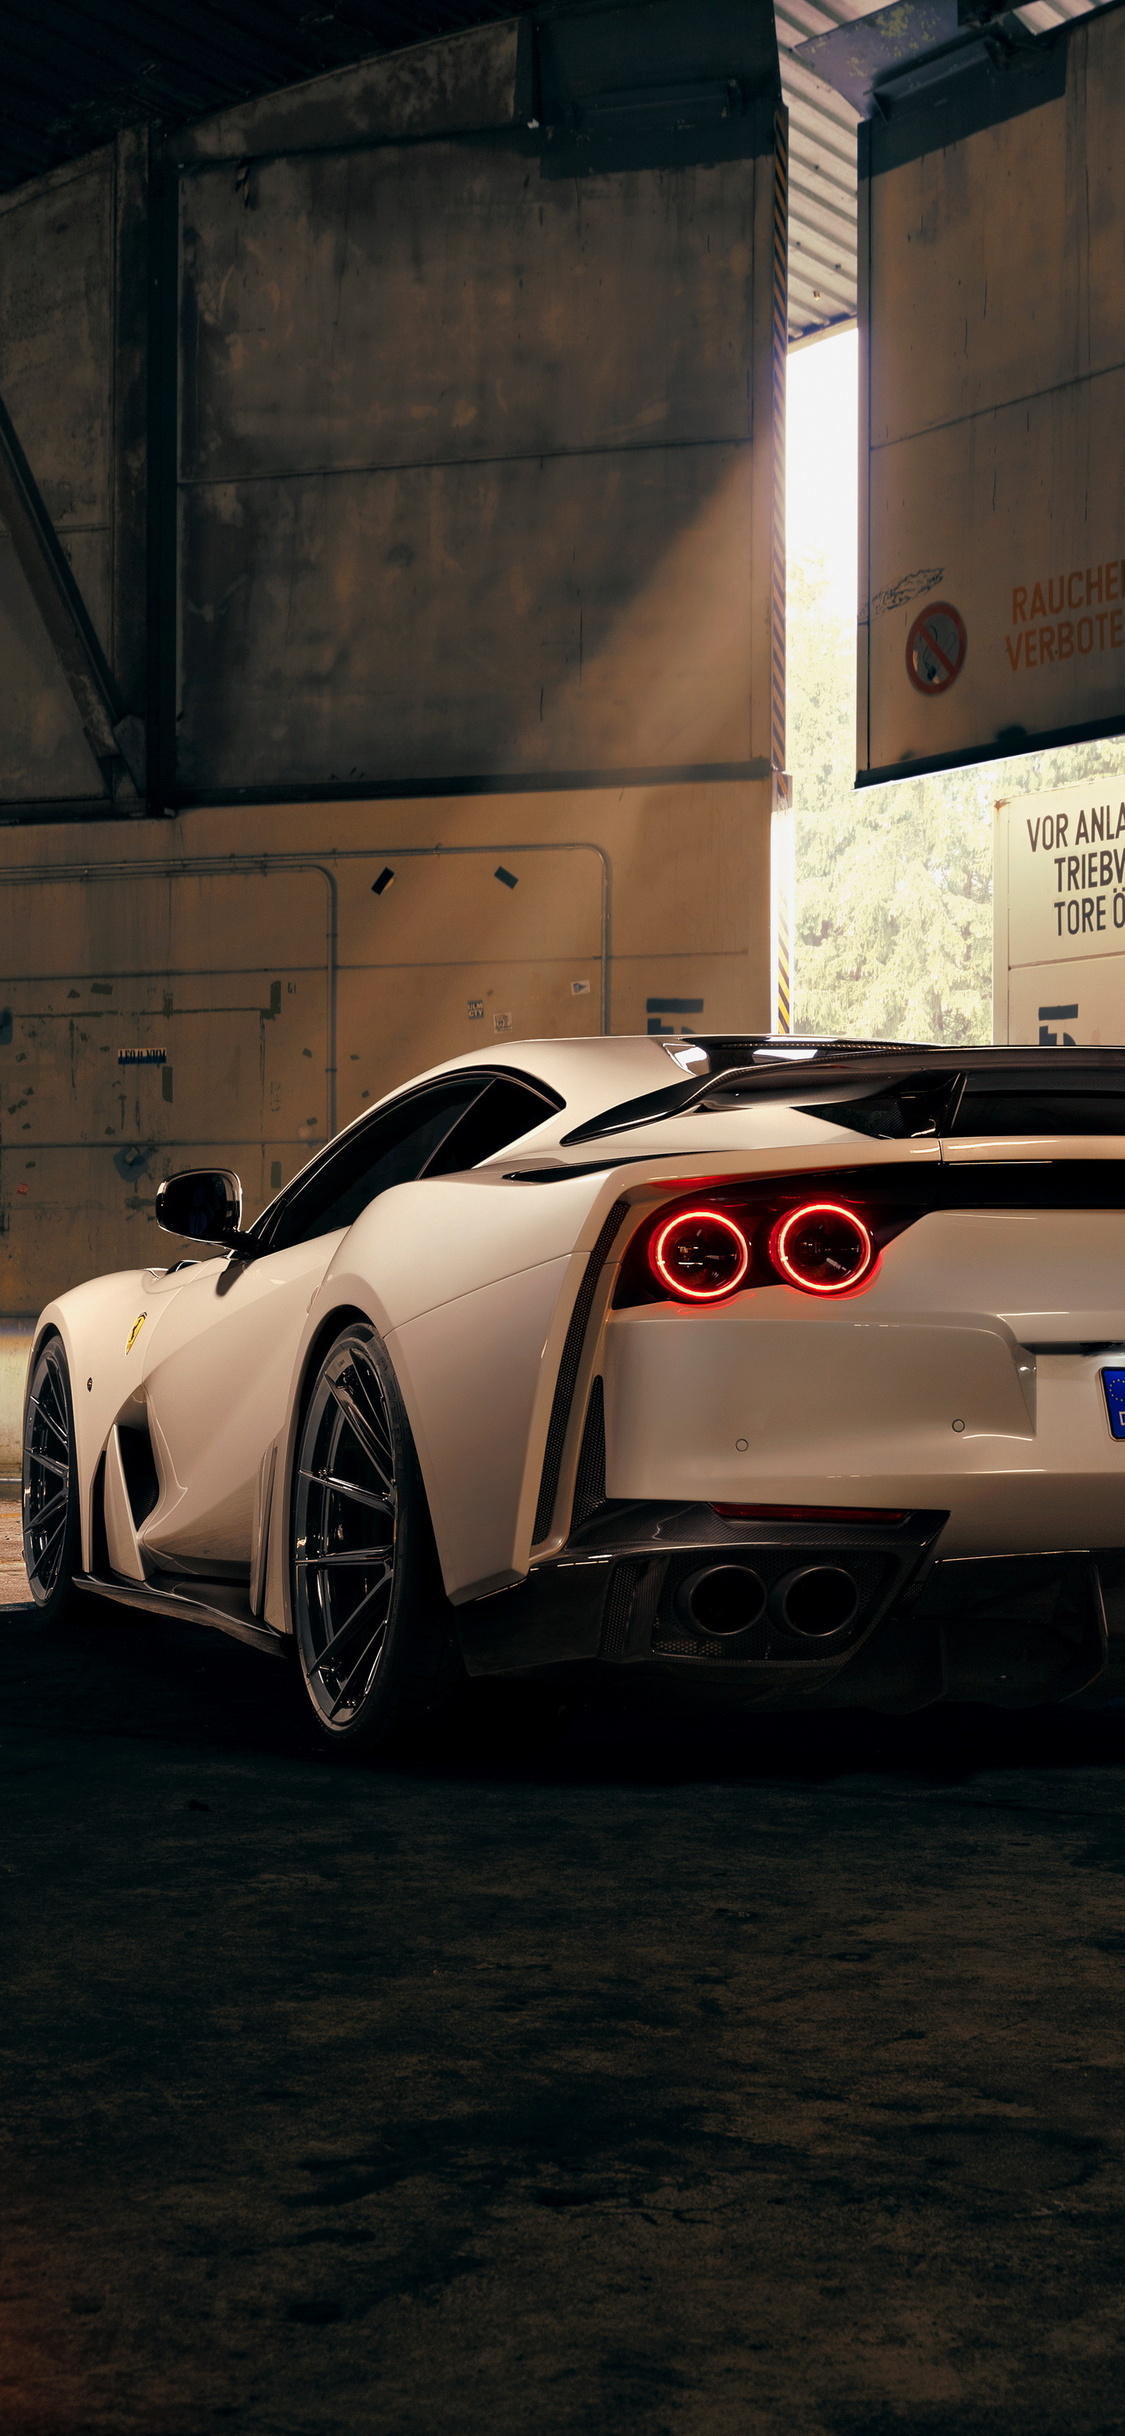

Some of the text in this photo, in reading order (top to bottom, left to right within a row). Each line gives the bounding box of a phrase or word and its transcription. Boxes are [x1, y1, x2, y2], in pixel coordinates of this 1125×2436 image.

[1012, 559, 1125, 625] RAUCHE
[1004, 609, 1125, 672] VERBOTE
[1026, 812, 1069, 853] VOR
[1054, 895, 1107, 937] TORE
